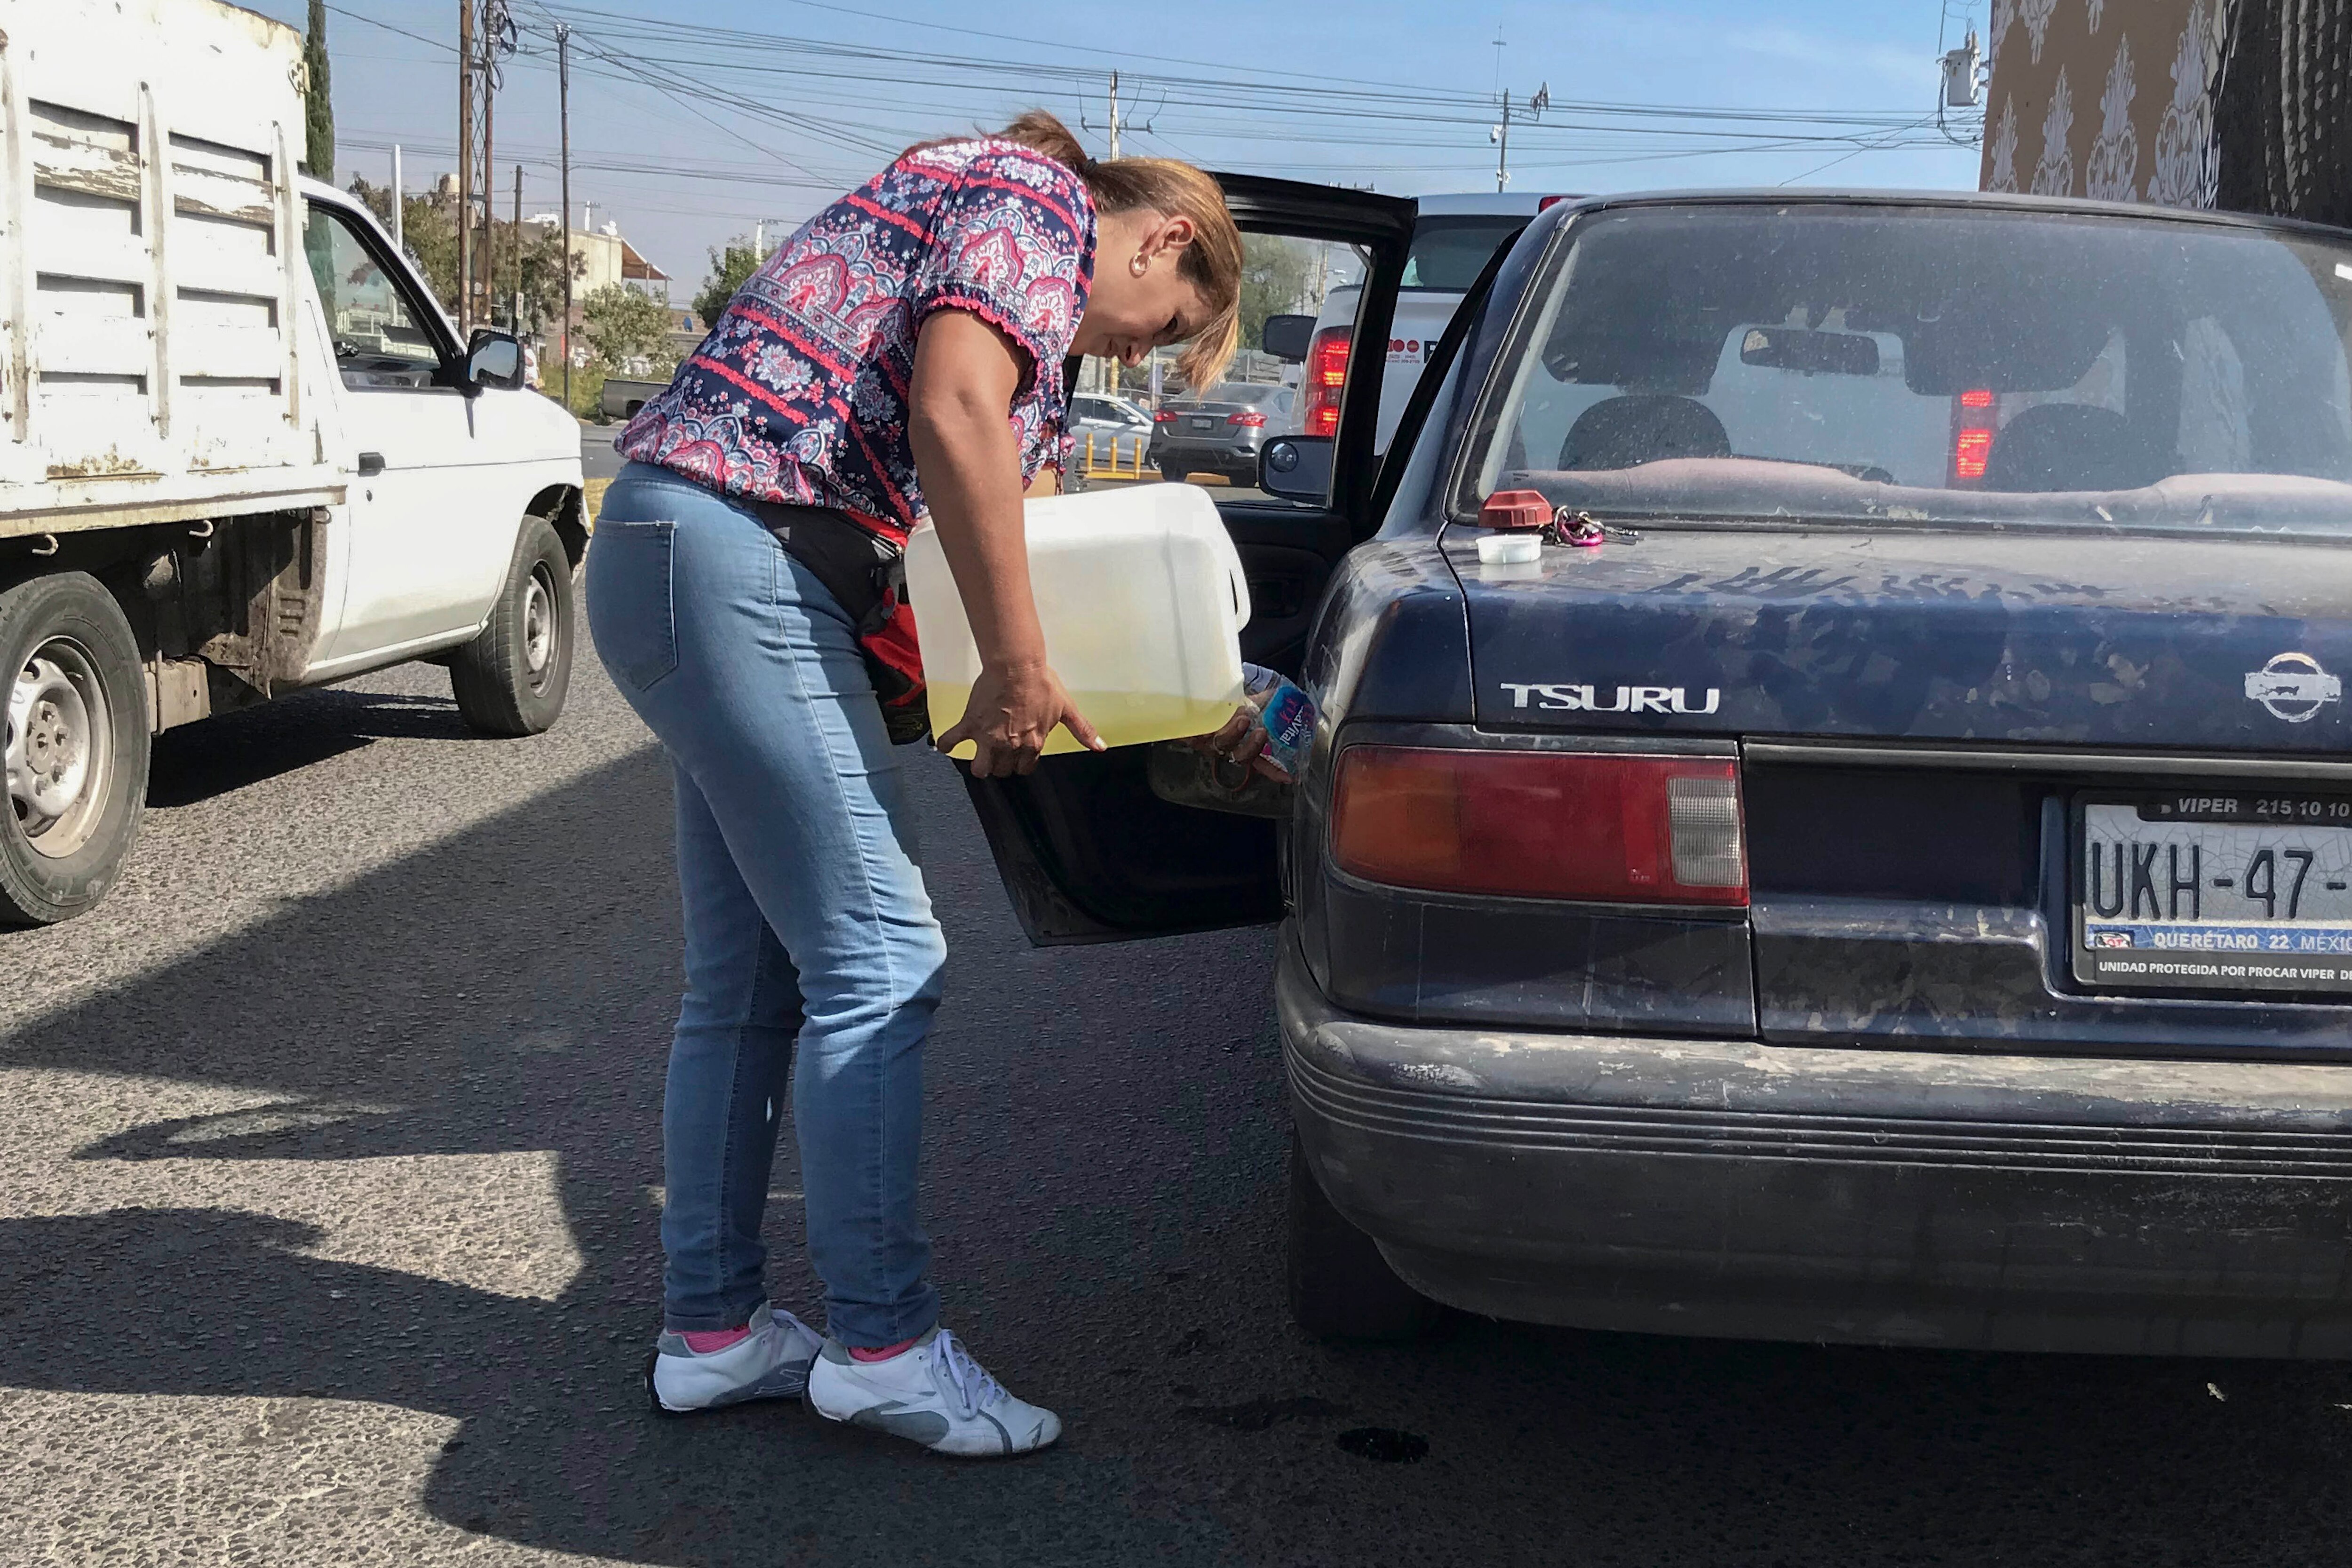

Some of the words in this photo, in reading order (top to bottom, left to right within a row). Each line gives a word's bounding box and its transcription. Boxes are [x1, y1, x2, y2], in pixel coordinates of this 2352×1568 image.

[1500, 682, 1720, 714] TSURU
[2178, 798, 2238, 813] VIPER
[2256, 799, 2292, 815] 215
[2299, 801, 2322, 816] 10
[2329, 802, 2350, 817] 10
[2153, 930, 2258, 949] QUERÉTARO
[2268, 934, 2290, 950] 22
[2098, 961, 2147, 973] UNIDAD
[2149, 963, 2218, 976] PROTEGIDA
[2221, 965, 2246, 977] POR
[2248, 966, 2297, 978] PROCAR
[2300, 968, 2335, 980] VIPER
